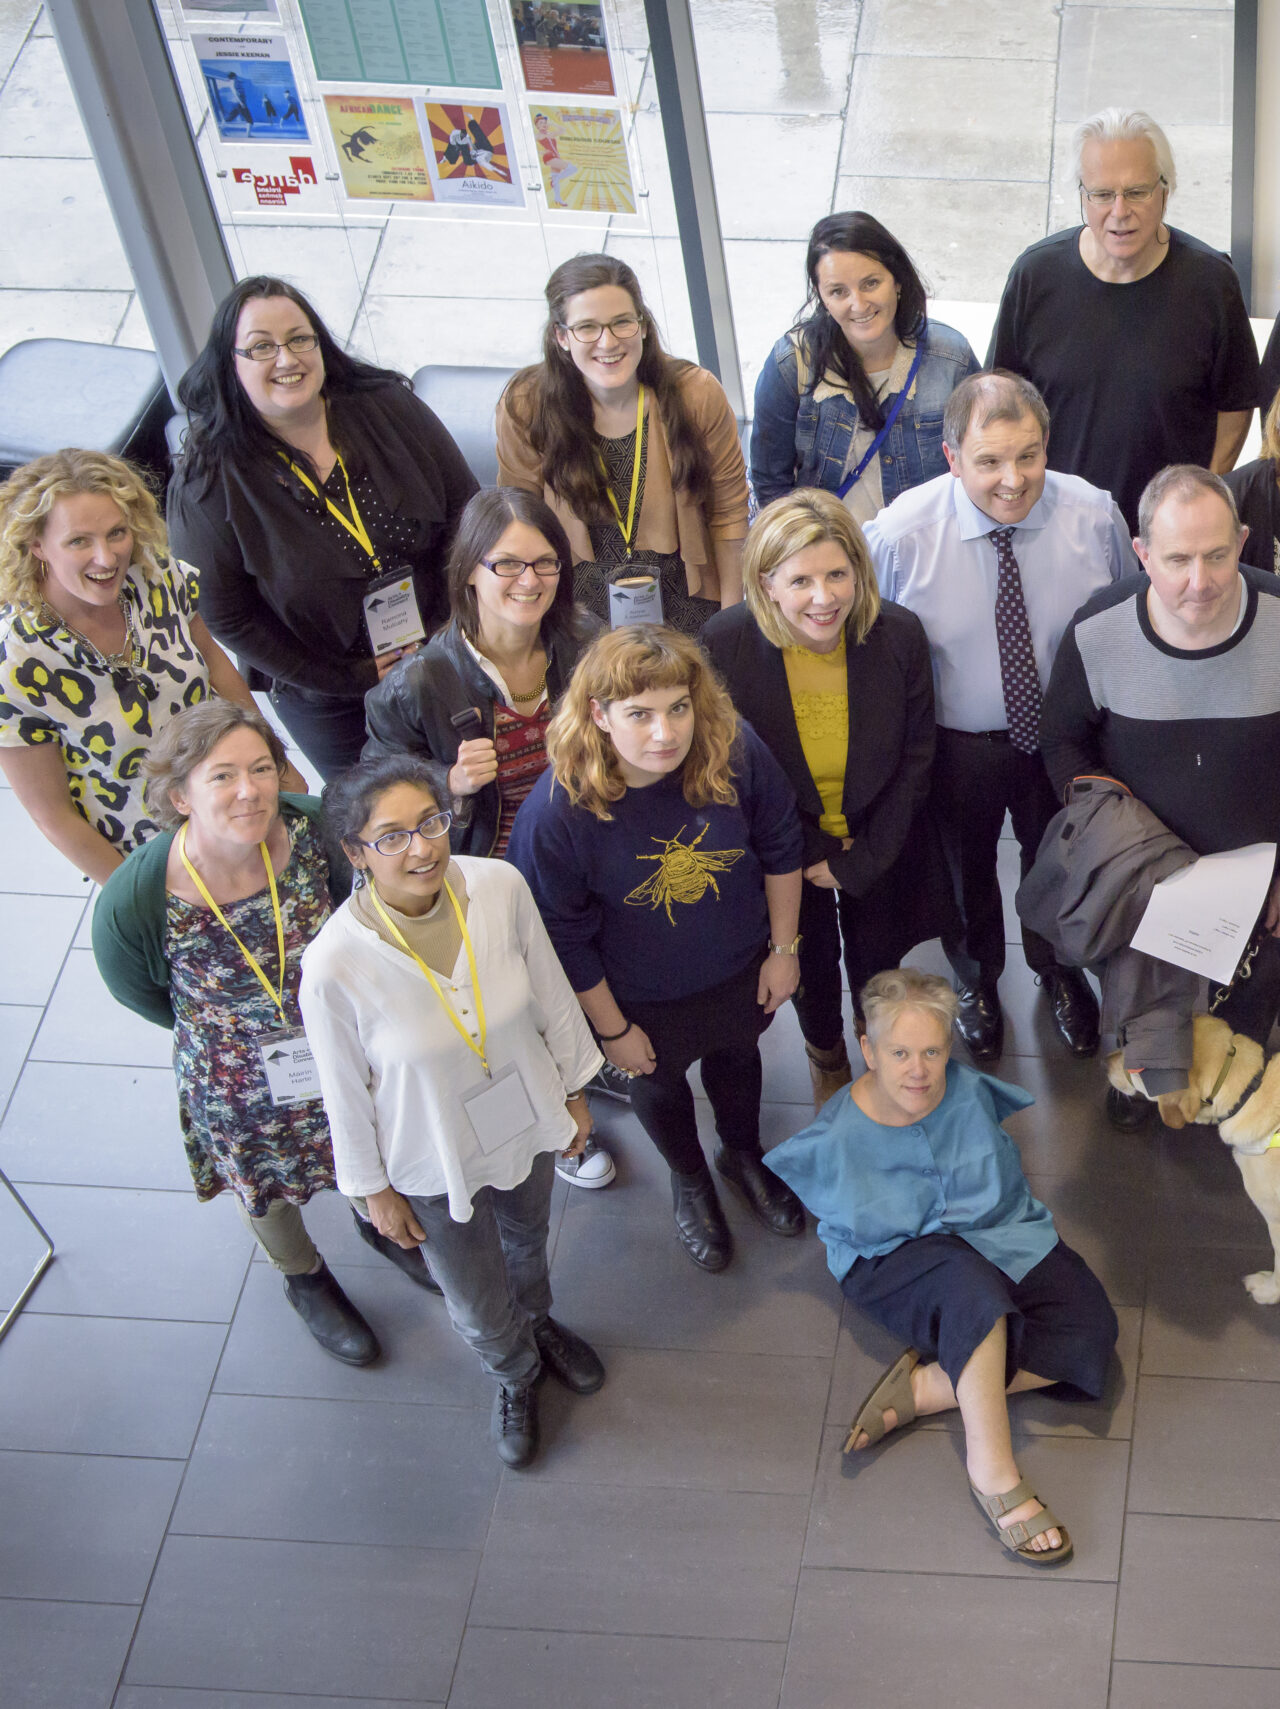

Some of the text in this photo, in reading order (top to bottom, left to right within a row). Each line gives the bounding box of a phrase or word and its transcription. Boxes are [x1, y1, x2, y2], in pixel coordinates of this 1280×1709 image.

[208, 36, 273, 44] CONTEMPORARY
[369, 103, 402, 114] DANCE
[462, 180, 494, 190] Aikido
